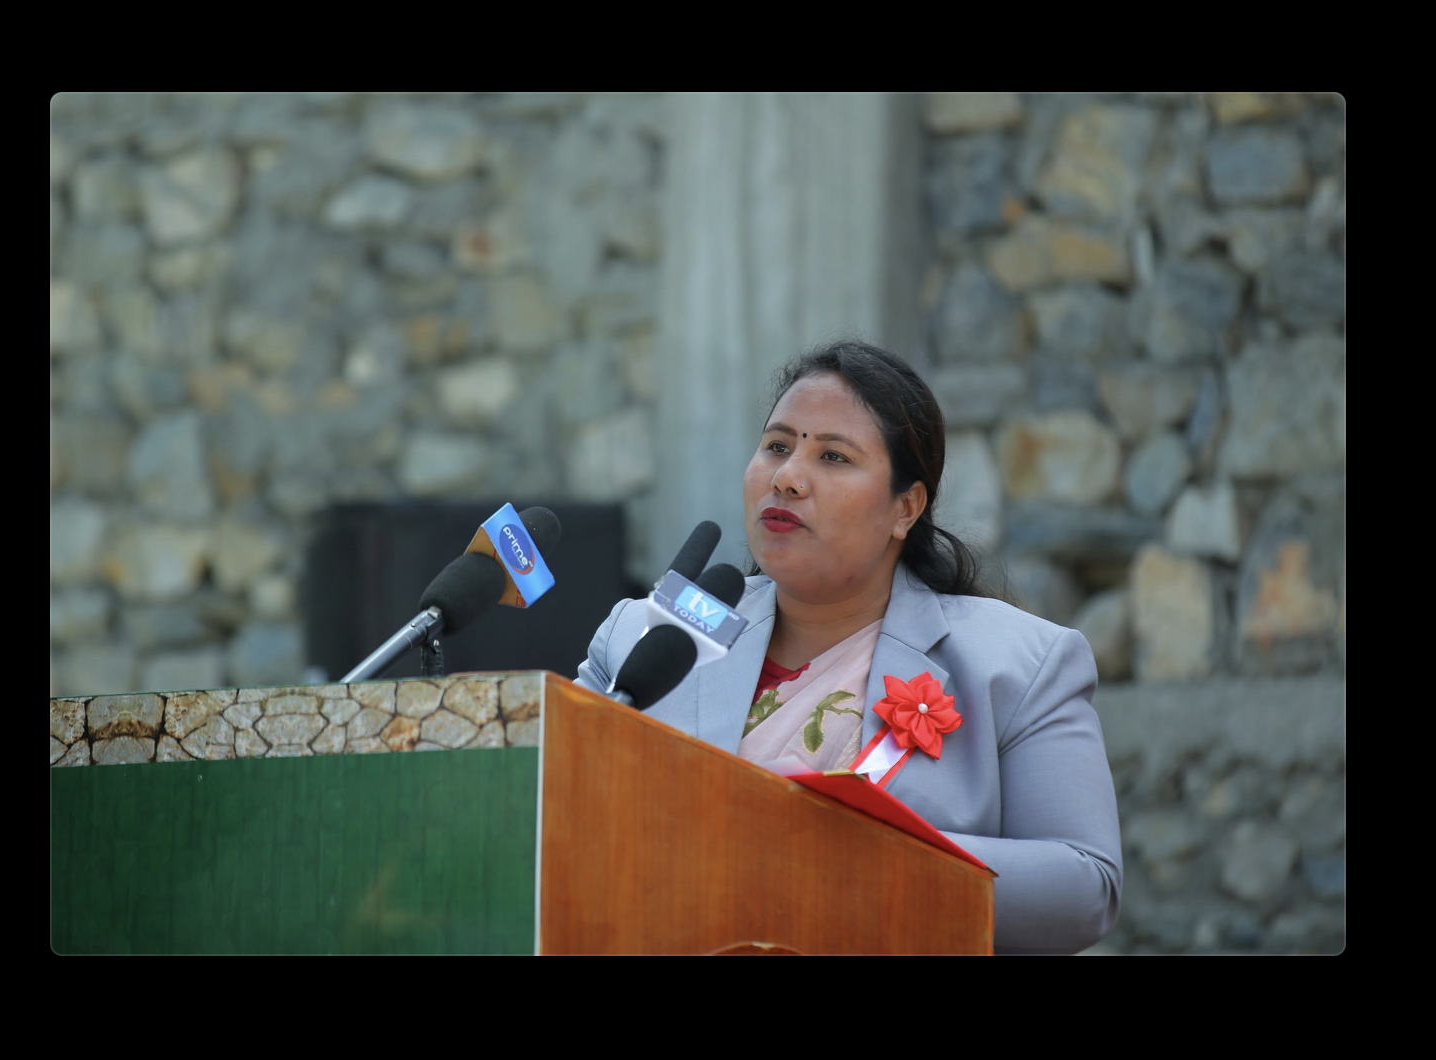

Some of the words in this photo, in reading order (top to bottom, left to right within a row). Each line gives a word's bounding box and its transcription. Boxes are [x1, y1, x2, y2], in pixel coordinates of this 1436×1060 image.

[503, 526, 528, 566] prime
[674, 604, 714, 633] TODAY
[688, 591, 719, 618] tv
